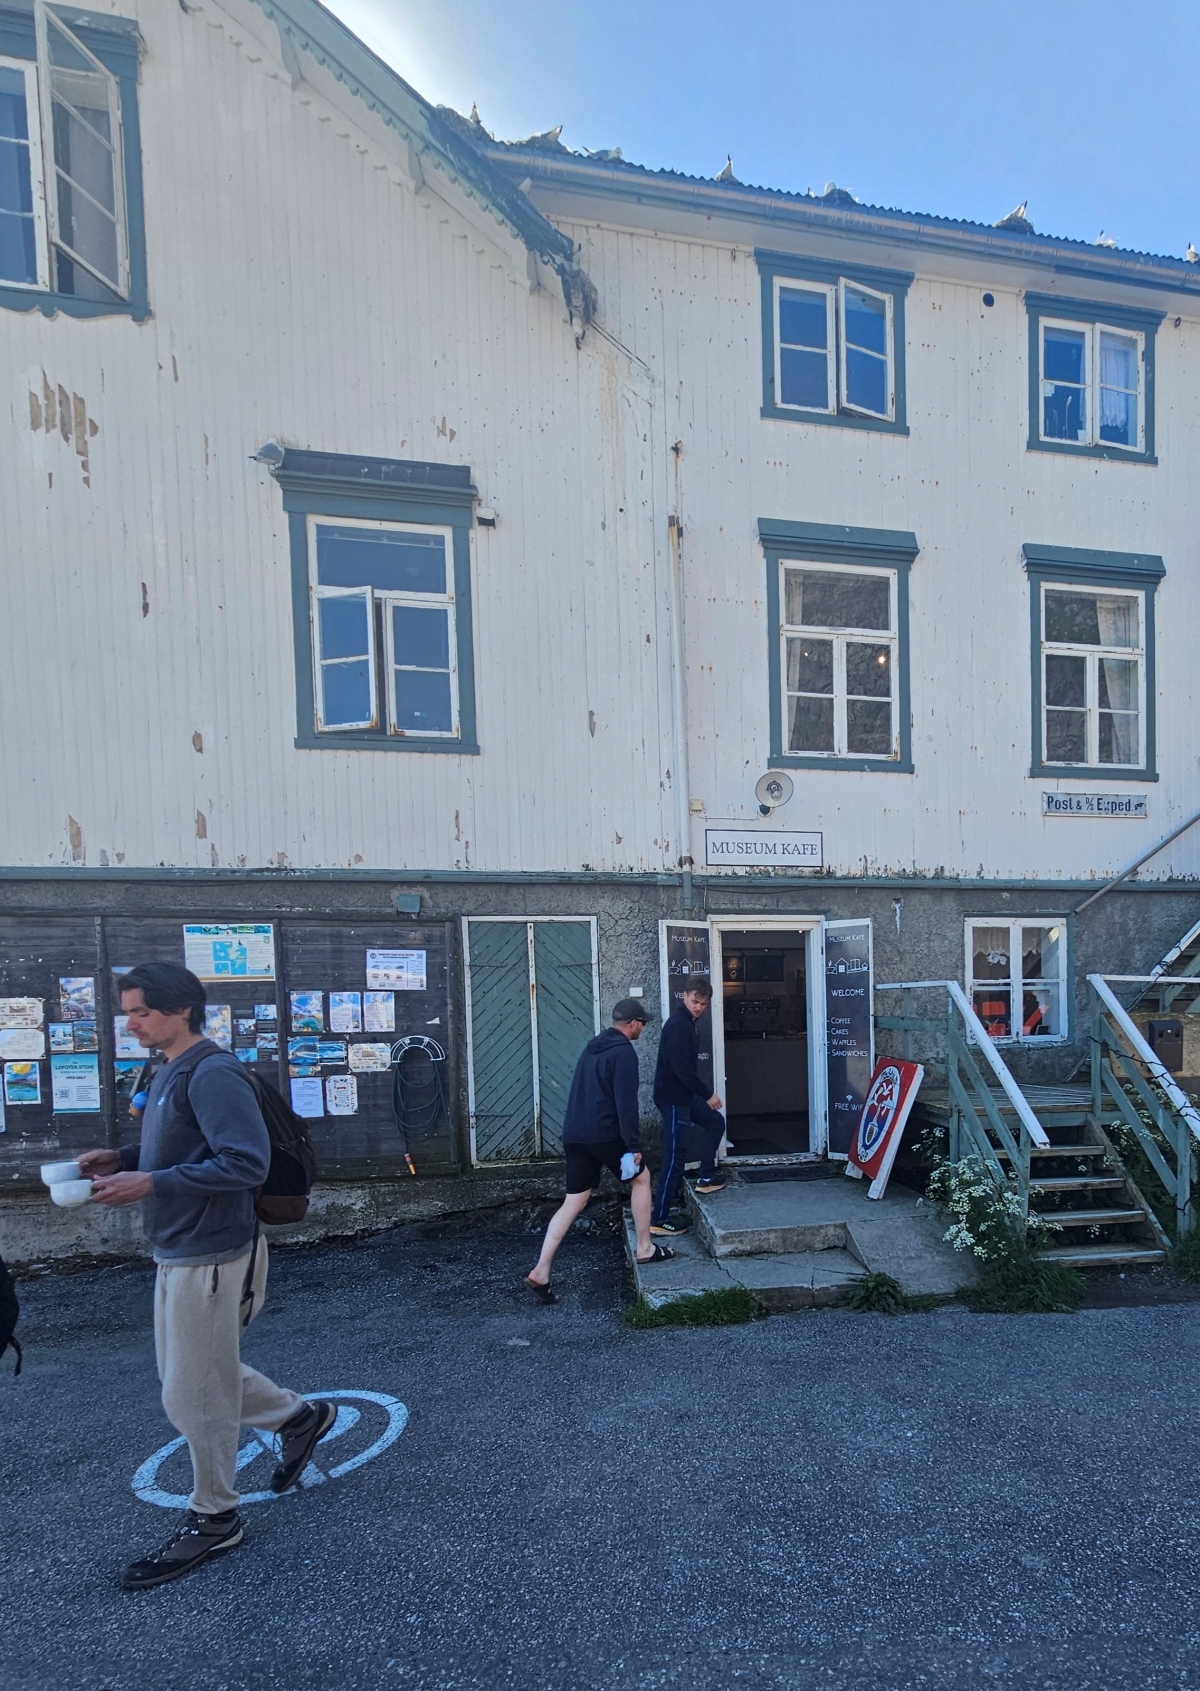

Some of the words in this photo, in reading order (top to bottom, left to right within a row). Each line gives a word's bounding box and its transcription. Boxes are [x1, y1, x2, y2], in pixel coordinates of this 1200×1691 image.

[1047, 795, 1073, 810] Post
[1076, 800, 1083, 810] &
[711, 842, 777, 855] MUSEUM
[781, 843, 818, 855] KAFE
[831, 988, 865, 997] WELCOME
[831, 1049, 868, 1057] SANDWICHES
[834, 1102, 849, 1110] FREE
